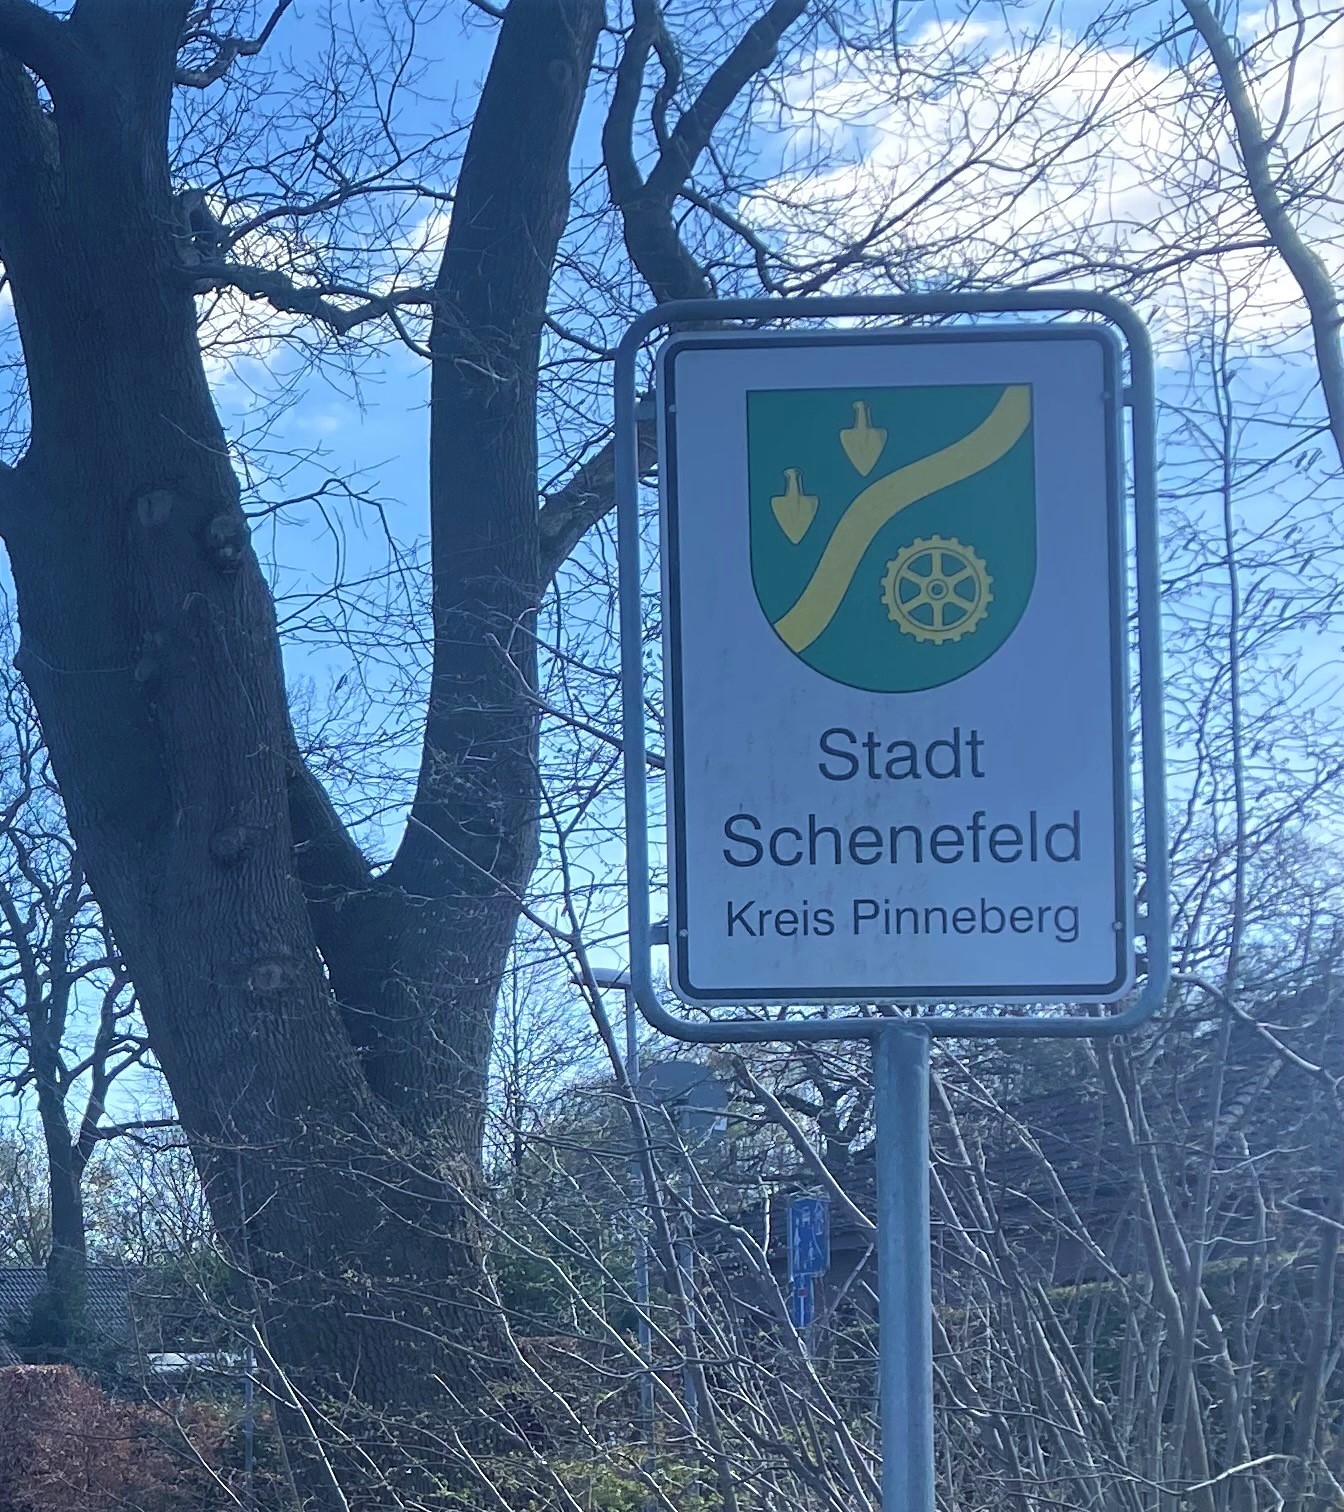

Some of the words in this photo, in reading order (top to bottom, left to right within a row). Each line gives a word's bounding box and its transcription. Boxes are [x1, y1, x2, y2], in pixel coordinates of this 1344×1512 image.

[818, 726, 986, 781] Stadt
[722, 810, 1082, 867] Schenefeld
[726, 901, 835, 937] Kreis
[852, 897, 1080, 942] Pinneberg
